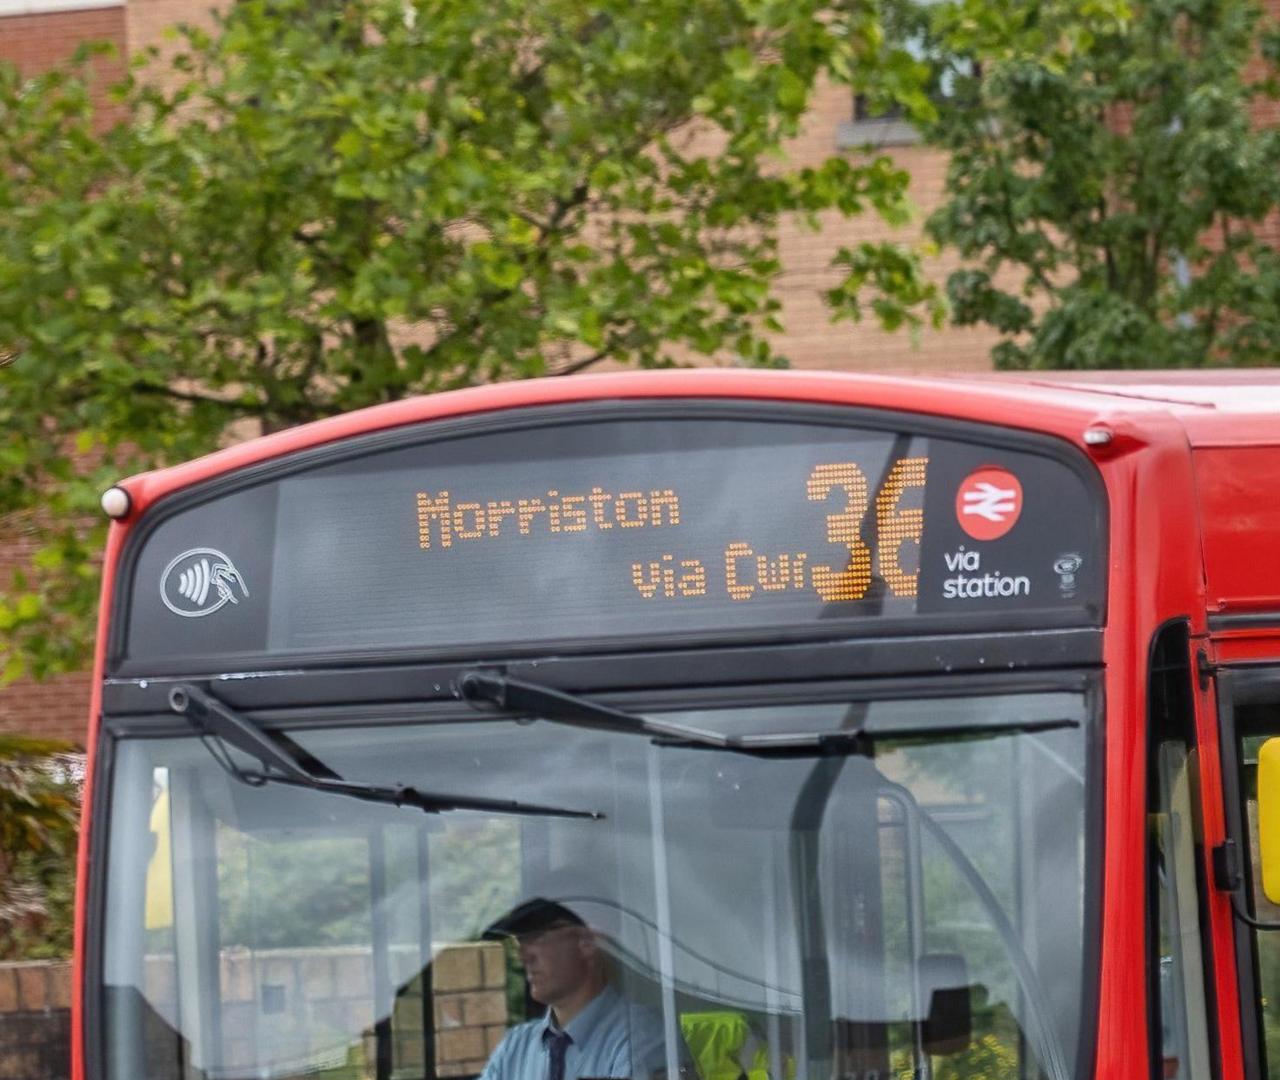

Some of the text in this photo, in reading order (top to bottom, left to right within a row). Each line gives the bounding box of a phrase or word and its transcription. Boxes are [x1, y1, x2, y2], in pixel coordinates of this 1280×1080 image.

[417, 487, 680, 548] Morriston
[807, 457, 929, 601] 36
[632, 555, 705, 598] via
[944, 545, 980, 571] via
[943, 571, 1030, 598] station
